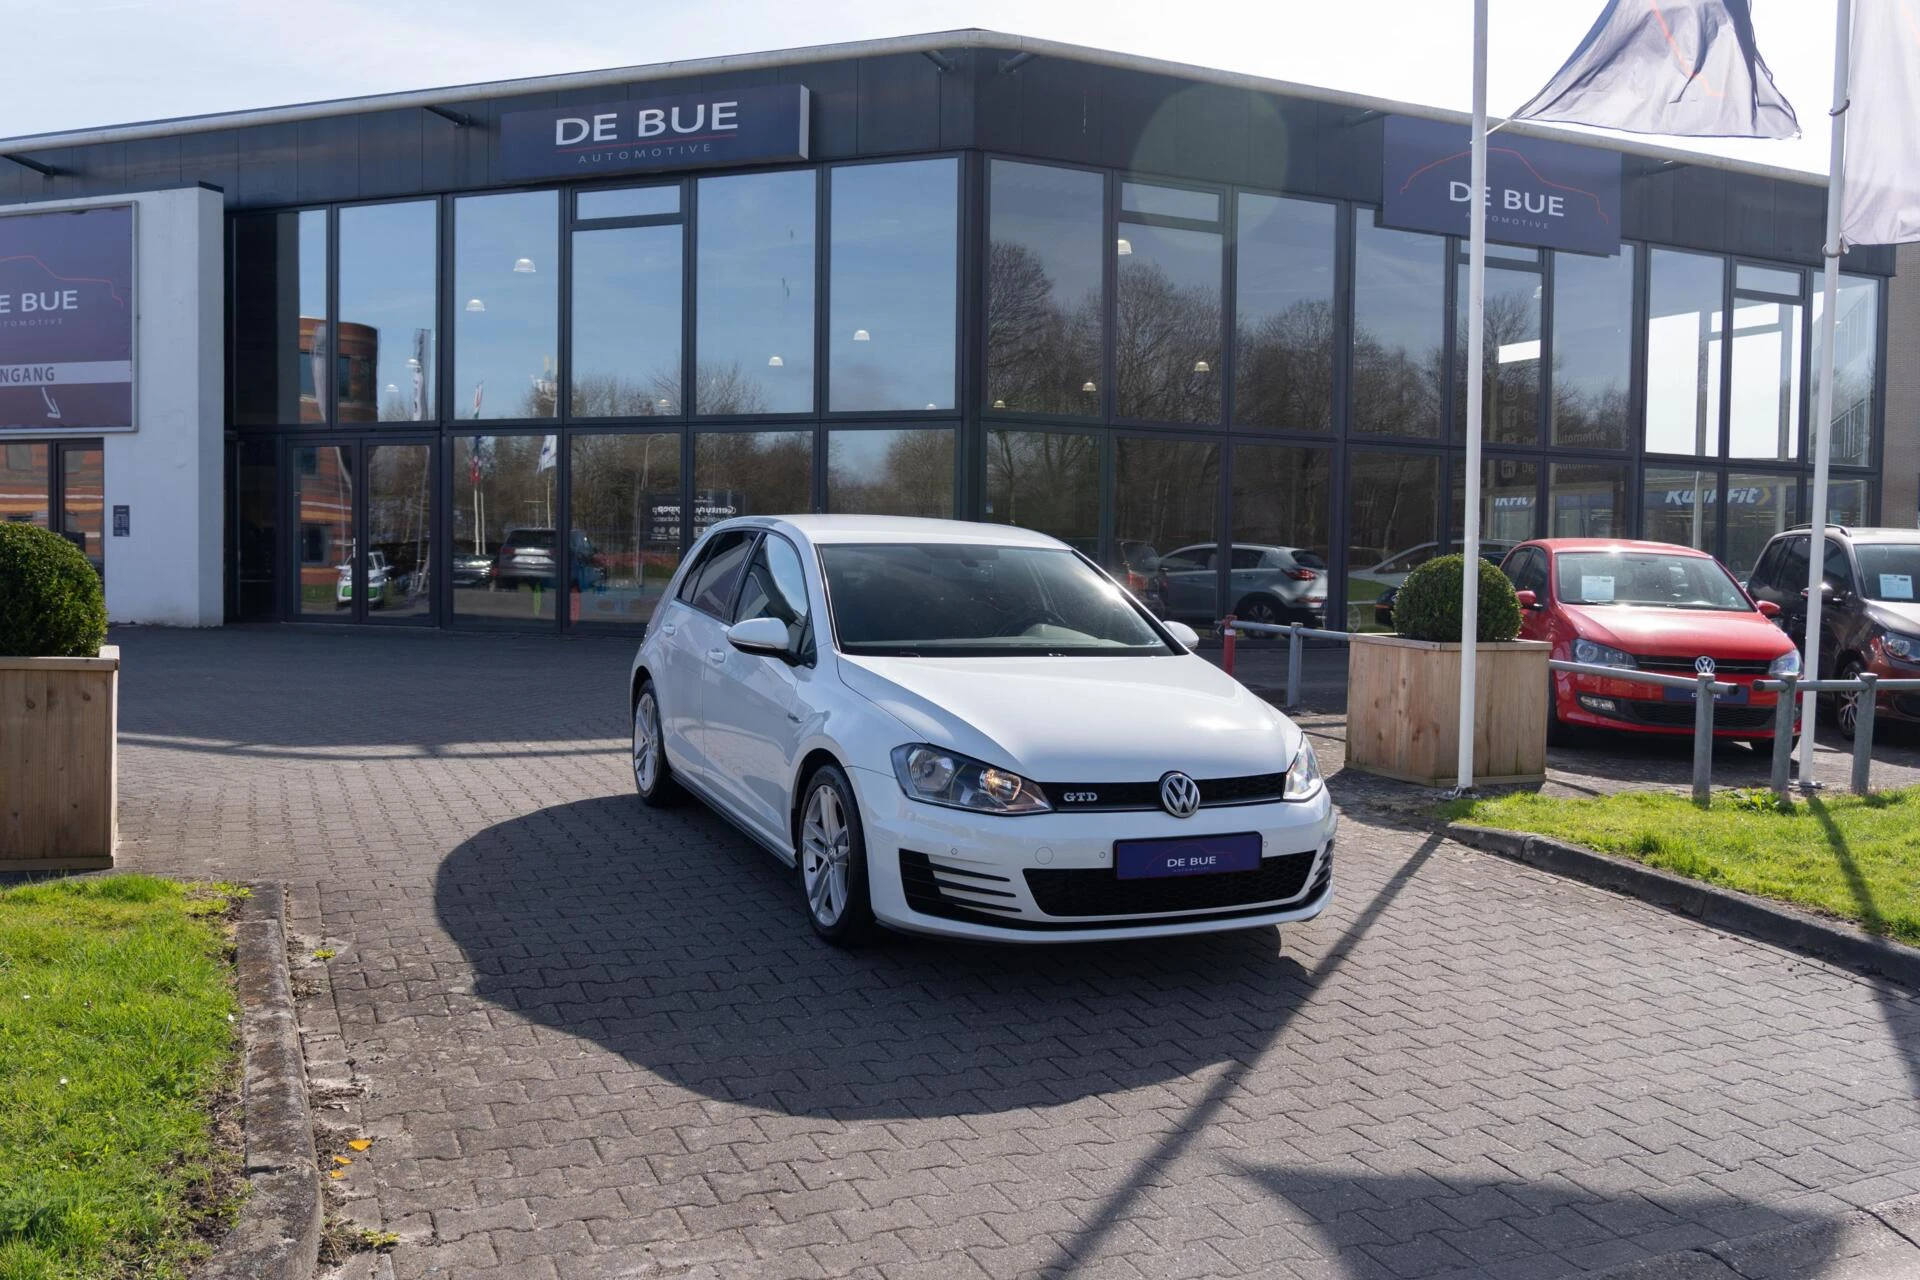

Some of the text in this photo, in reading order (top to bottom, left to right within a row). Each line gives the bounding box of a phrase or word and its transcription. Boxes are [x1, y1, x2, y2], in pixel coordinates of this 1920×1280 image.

[556, 101, 739, 146] DE BUE
[578, 143, 712, 165] AUTOMOTIVE
[1503, 189, 1565, 217] BUE
[1464, 211, 1550, 230] ATOMOTIVE
[0, 289, 79, 314] E BUE
[0, 366, 55, 384] NGANG
[1063, 791, 1098, 802] GTD
[1167, 856, 1217, 867] DE BUE
